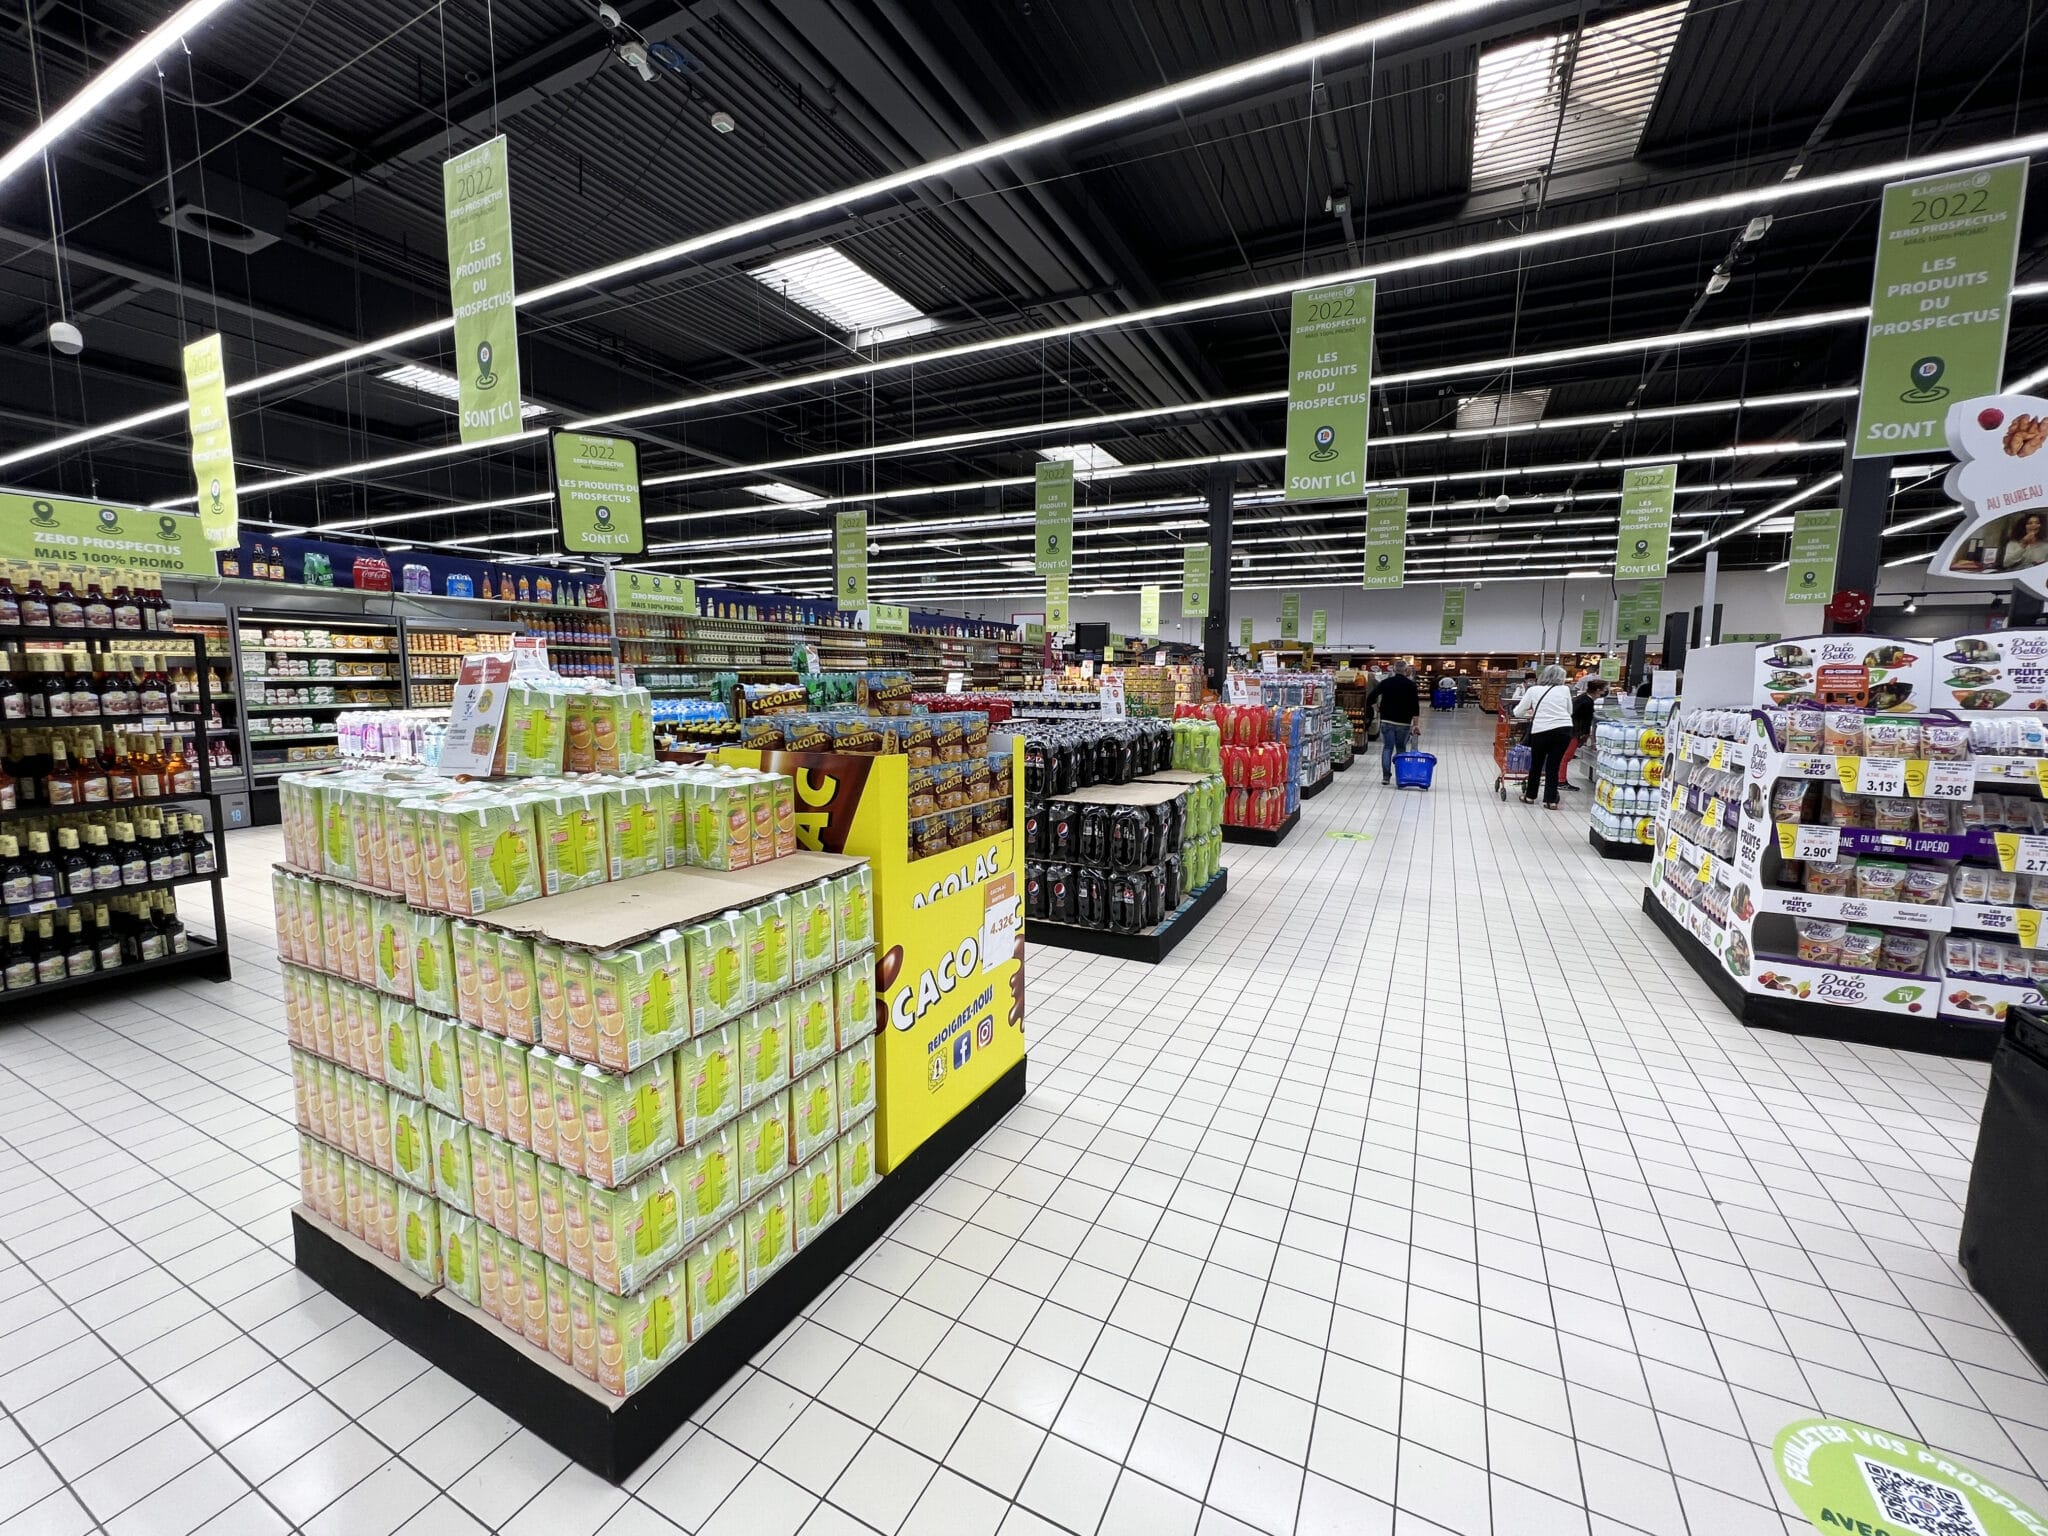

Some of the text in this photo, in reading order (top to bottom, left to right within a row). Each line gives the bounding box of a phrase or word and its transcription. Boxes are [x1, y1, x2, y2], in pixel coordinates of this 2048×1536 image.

[457, 166, 493, 202] 2022
[1909, 189, 1989, 224] 2022
[1889, 211, 2007, 240] ZERO PROSPECTUS
[469, 237, 486, 254] LES
[456, 253, 502, 280] PRODUITS
[1922, 256, 1957, 273] LES
[473, 277, 487, 293] DU
[1887, 271, 1989, 297] PRODUITS
[454, 290, 511, 321] PROSPECTUS
[1307, 298, 1355, 323] 2022
[1919, 296, 1950, 312] DU
[1296, 316, 1367, 334] ZERO PROSPECTUS
[1872, 308, 2000, 337] PROSPECTUS
[1317, 352, 1338, 364] LES
[1297, 364, 1358, 381] PRODUITS
[1317, 382, 1335, 394] DU
[1289, 393, 1366, 411] PROSPECTUS
[464, 401, 514, 428] SONT ICI
[1867, 420, 1936, 440] SONT
[581, 444, 615, 459] 2022
[1044, 469, 1064, 480] 2022
[1290, 471, 1356, 490] SONT ICI
[1634, 474, 1664, 487] 2022
[559, 479, 640, 493] LES PRODUITS DU
[571, 491, 631, 503] PROSPECTUS
[1376, 497, 1398, 507] 2022
[1987, 484, 2043, 511] AU BUREAU
[1626, 507, 1664, 515] PRODUITS
[1620, 522, 1669, 531] PROSPECTUS
[1804, 516, 1830, 526] 2022
[34, 532, 181, 556] ZERO PROSPECTUS
[581, 532, 629, 544] SONT ICI
[34, 548, 184, 570] MAIS 100% PROMO
[1038, 561, 1056, 569] SONT
[1619, 564, 1660, 573] SONT ICI
[1367, 576, 1387, 584] SONT
[1823, 643, 1854, 653] Daco
[2011, 646, 2048, 655] Bello
[2012, 637, 2047, 647] Daco
[1821, 651, 1854, 661] Bello
[2008, 668, 2048, 676] FRUITS
[752, 690, 803, 710] CACOLAC
[876, 684, 912, 700] CACOLAC
[742, 733, 778, 750] CACOLAC
[786, 733, 826, 752] CACOLAC
[833, 734, 874, 748] CACOLAC
[902, 730, 931, 749] CACOLAC
[937, 727, 962, 746] CACOLAC
[967, 727, 988, 743] CACOLAC
[936, 773, 962, 794] CACOLAC
[965, 766, 989, 785] CACOLAC
[1867, 780, 1898, 792] 3.13€
[1934, 784, 1967, 796] 2.36€
[976, 805, 1001, 824] CACOLAC
[917, 820, 946, 842] CACOLAC
[950, 815, 973, 835] CACOLAC
[1740, 830, 1761, 849] FRUITS
[1860, 834, 1870, 843] EN
[1741, 846, 1756, 863] SECS
[1803, 847, 1832, 858] 2.90€
[1782, 900, 1812, 908] FRUITS
[1842, 902, 1868, 911] Daco
[990, 913, 1014, 934] 4.32€
[891, 895, 1023, 1031] CACOC
[1822, 972, 1865, 989] Daco
[1817, 984, 1864, 999] Bello
[1898, 992, 1912, 1002] TV
[928, 984, 994, 1054] REJOIGNEZ-NOUS
[1784, 1425, 1853, 1487] FEUILLETER
[1853, 1428, 1908, 1456] VOS
